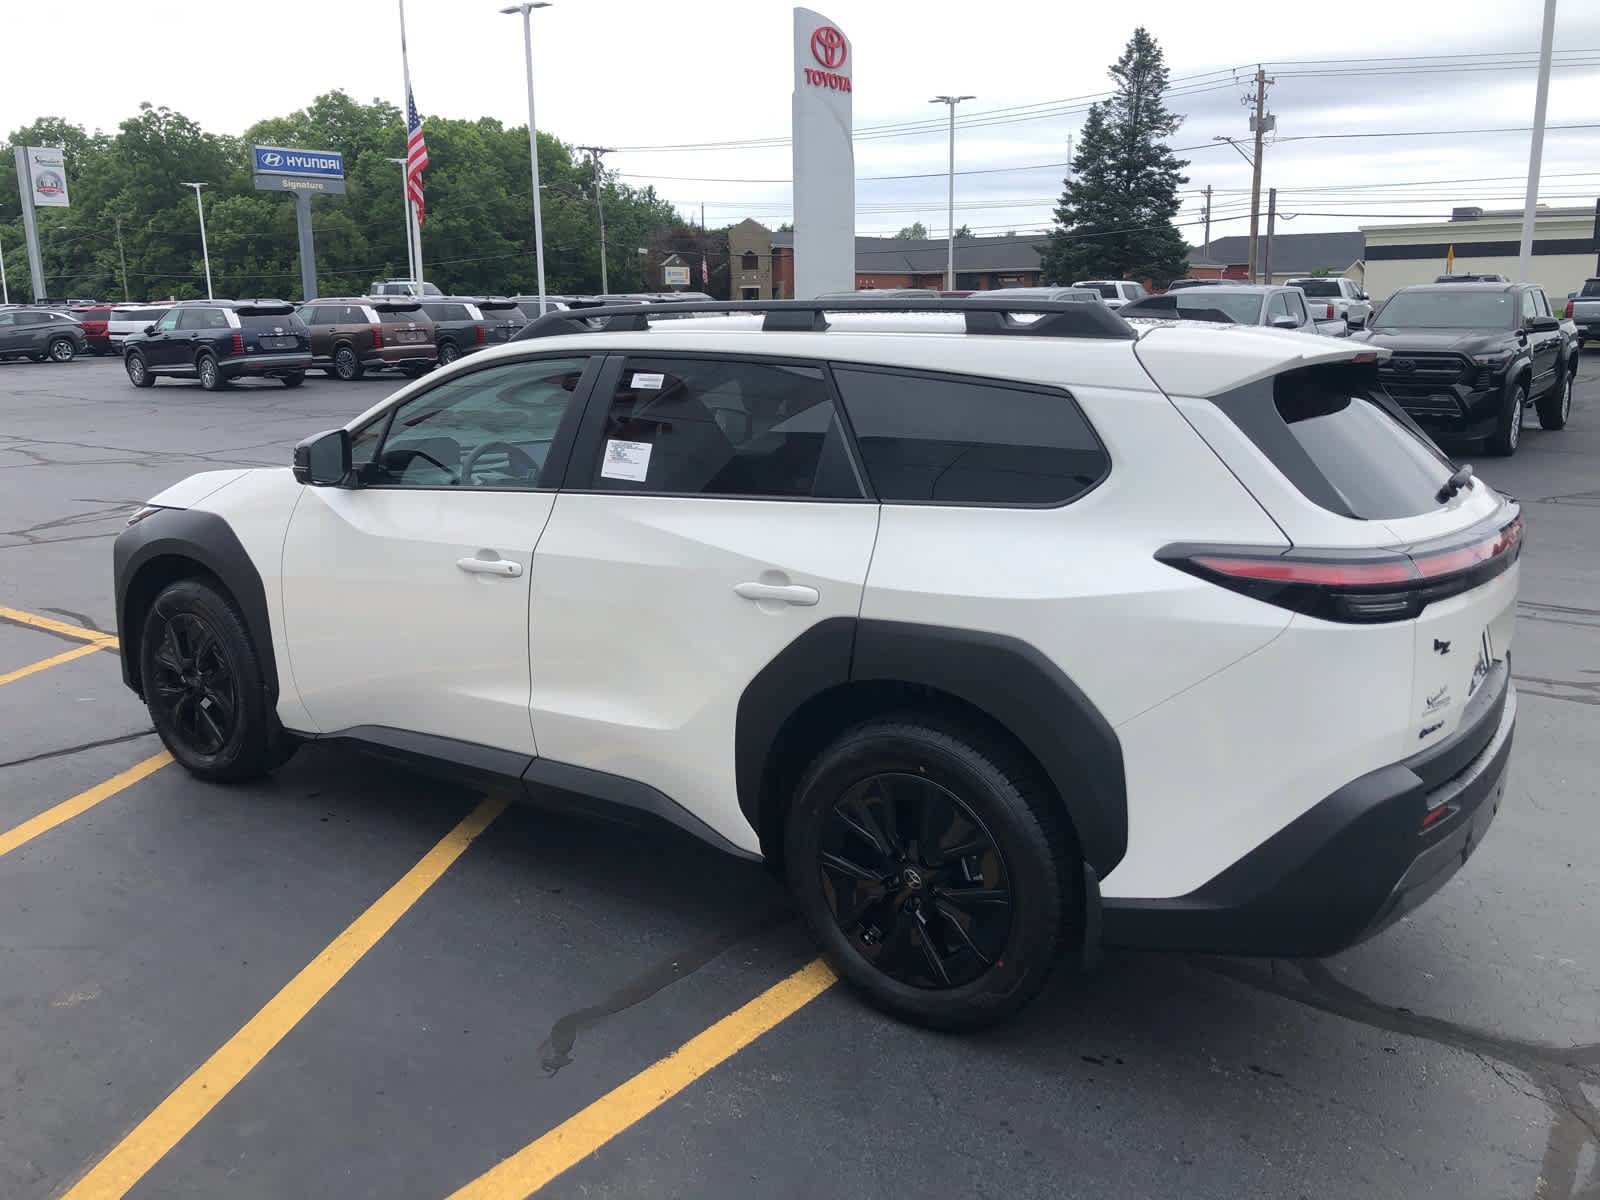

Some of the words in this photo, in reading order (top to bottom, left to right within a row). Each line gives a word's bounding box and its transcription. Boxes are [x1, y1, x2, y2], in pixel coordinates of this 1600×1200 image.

[804, 67, 851, 93] TOYOTA
[286, 156, 340, 170] HYUNDAI
[282, 179, 324, 190] Signature
